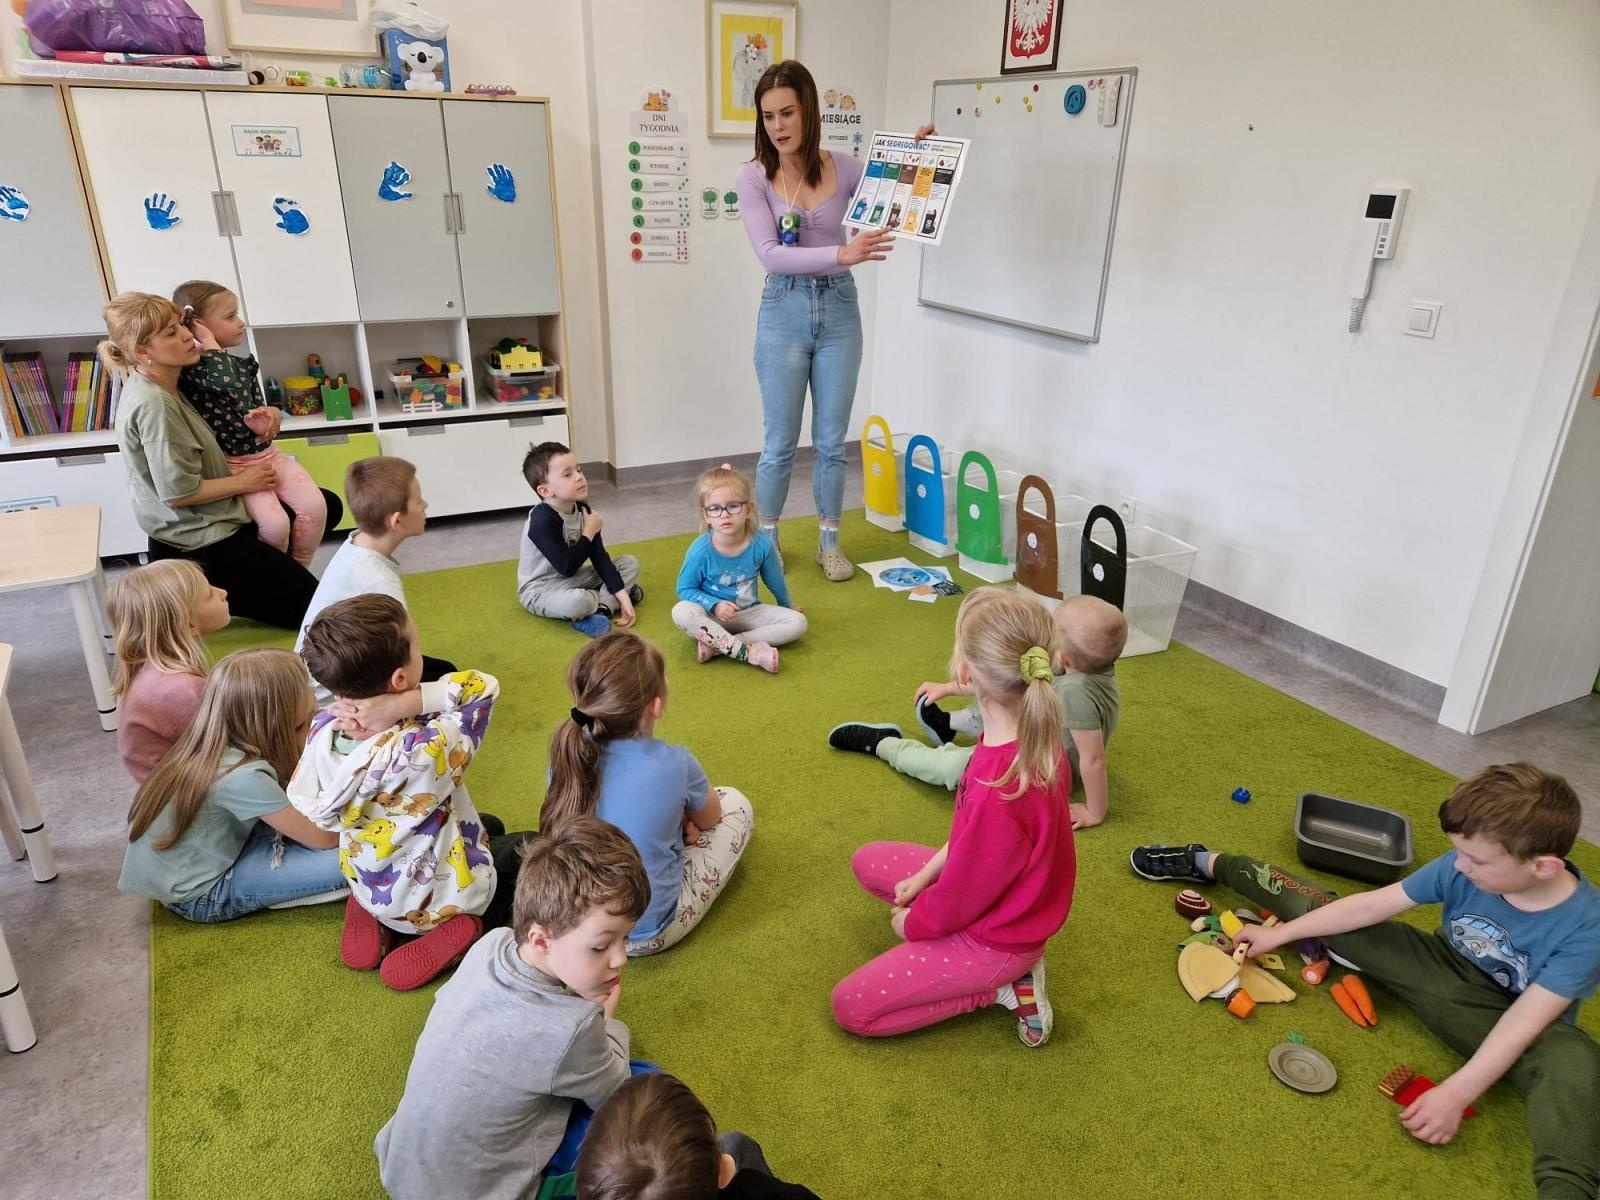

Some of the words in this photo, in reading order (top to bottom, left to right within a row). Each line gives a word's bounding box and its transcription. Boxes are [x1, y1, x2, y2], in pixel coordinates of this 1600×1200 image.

[652, 113, 666, 122] DNI
[639, 123, 680, 133] TYGODNIA
[887, 140, 930, 150] SEGREGOWAĆ?
